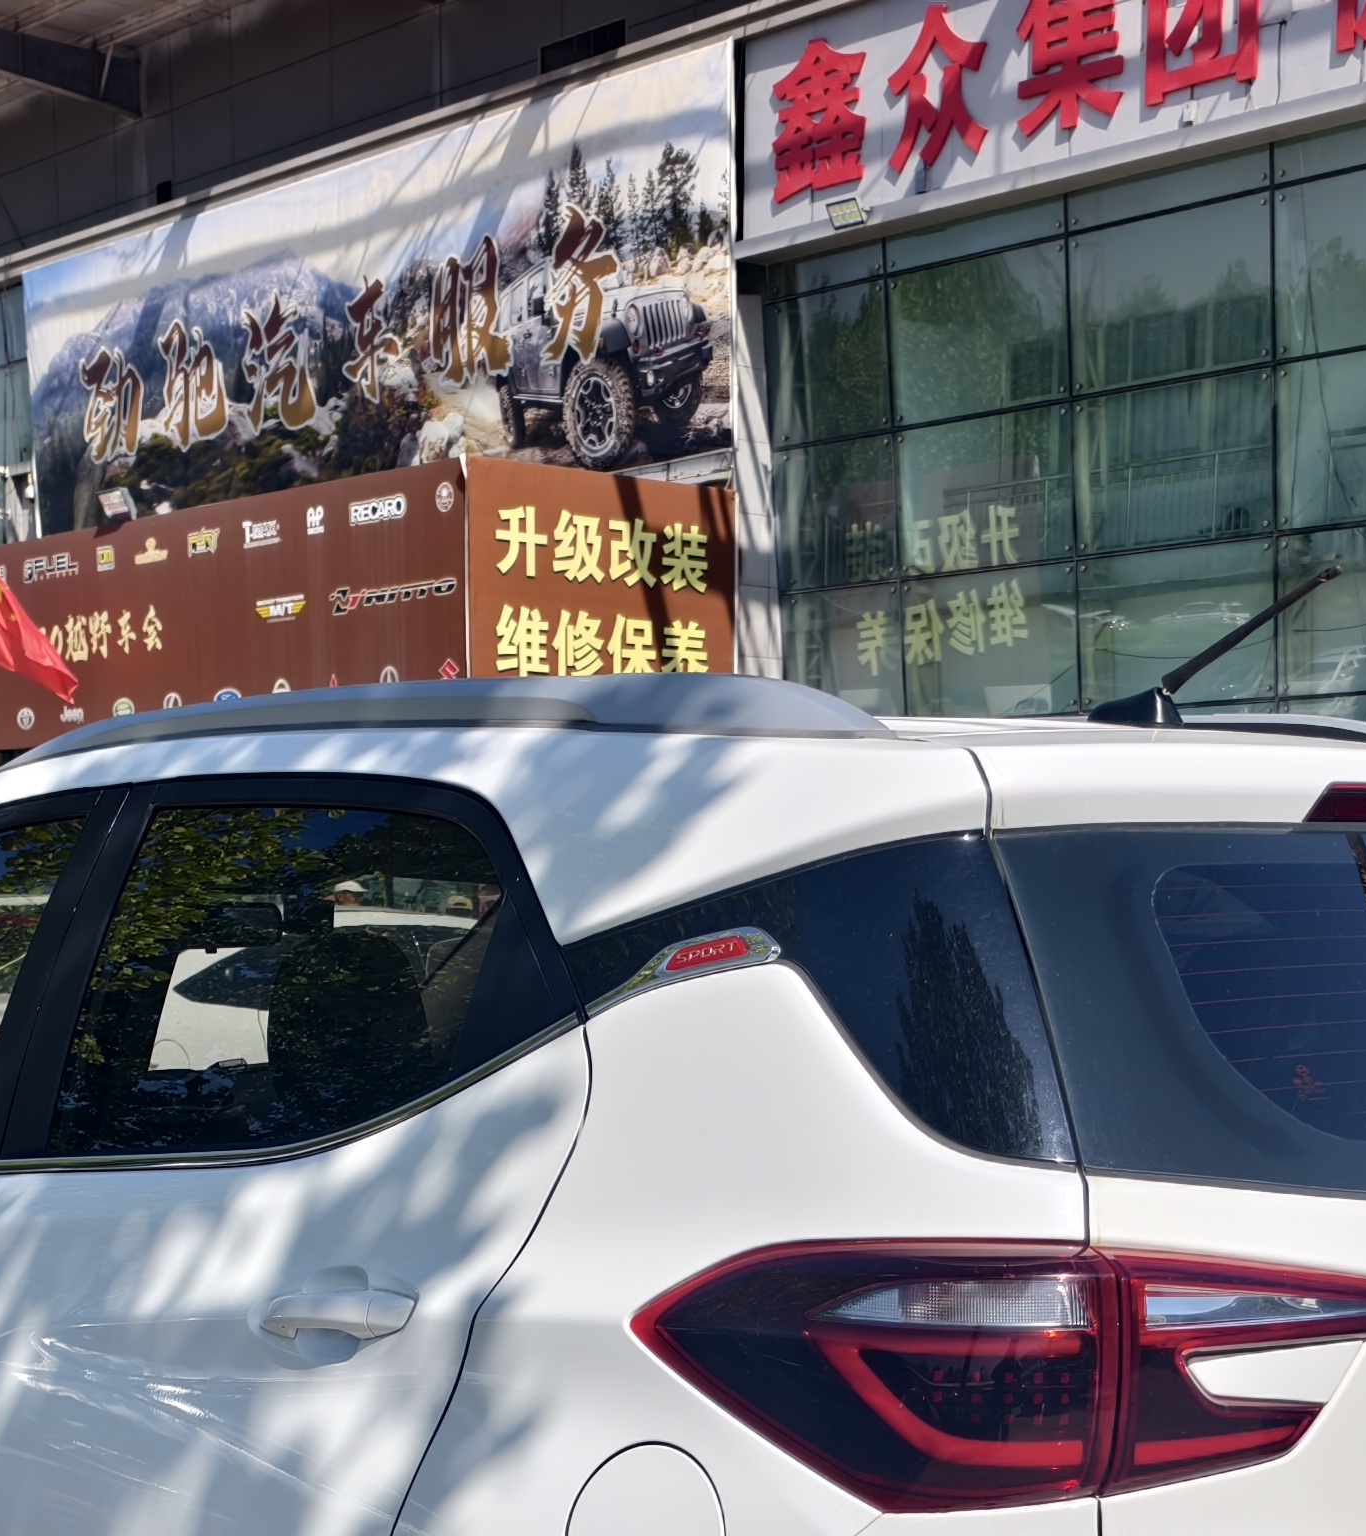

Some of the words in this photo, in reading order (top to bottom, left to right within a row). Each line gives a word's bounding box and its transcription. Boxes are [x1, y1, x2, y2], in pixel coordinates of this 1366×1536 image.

[772, 0, 1259, 205] 鑫众集团
[81, 203, 620, 464] 劲驰汽车服务
[350, 494, 406, 526] RECARO
[495, 505, 708, 594] 升级改装
[364, 577, 457, 607] NITTO
[40, 604, 163, 662] 0越野车会
[495, 603, 709, 678] 维修保养
[60, 705, 84, 724] Jeep
[675, 941, 737, 964] SPORT
